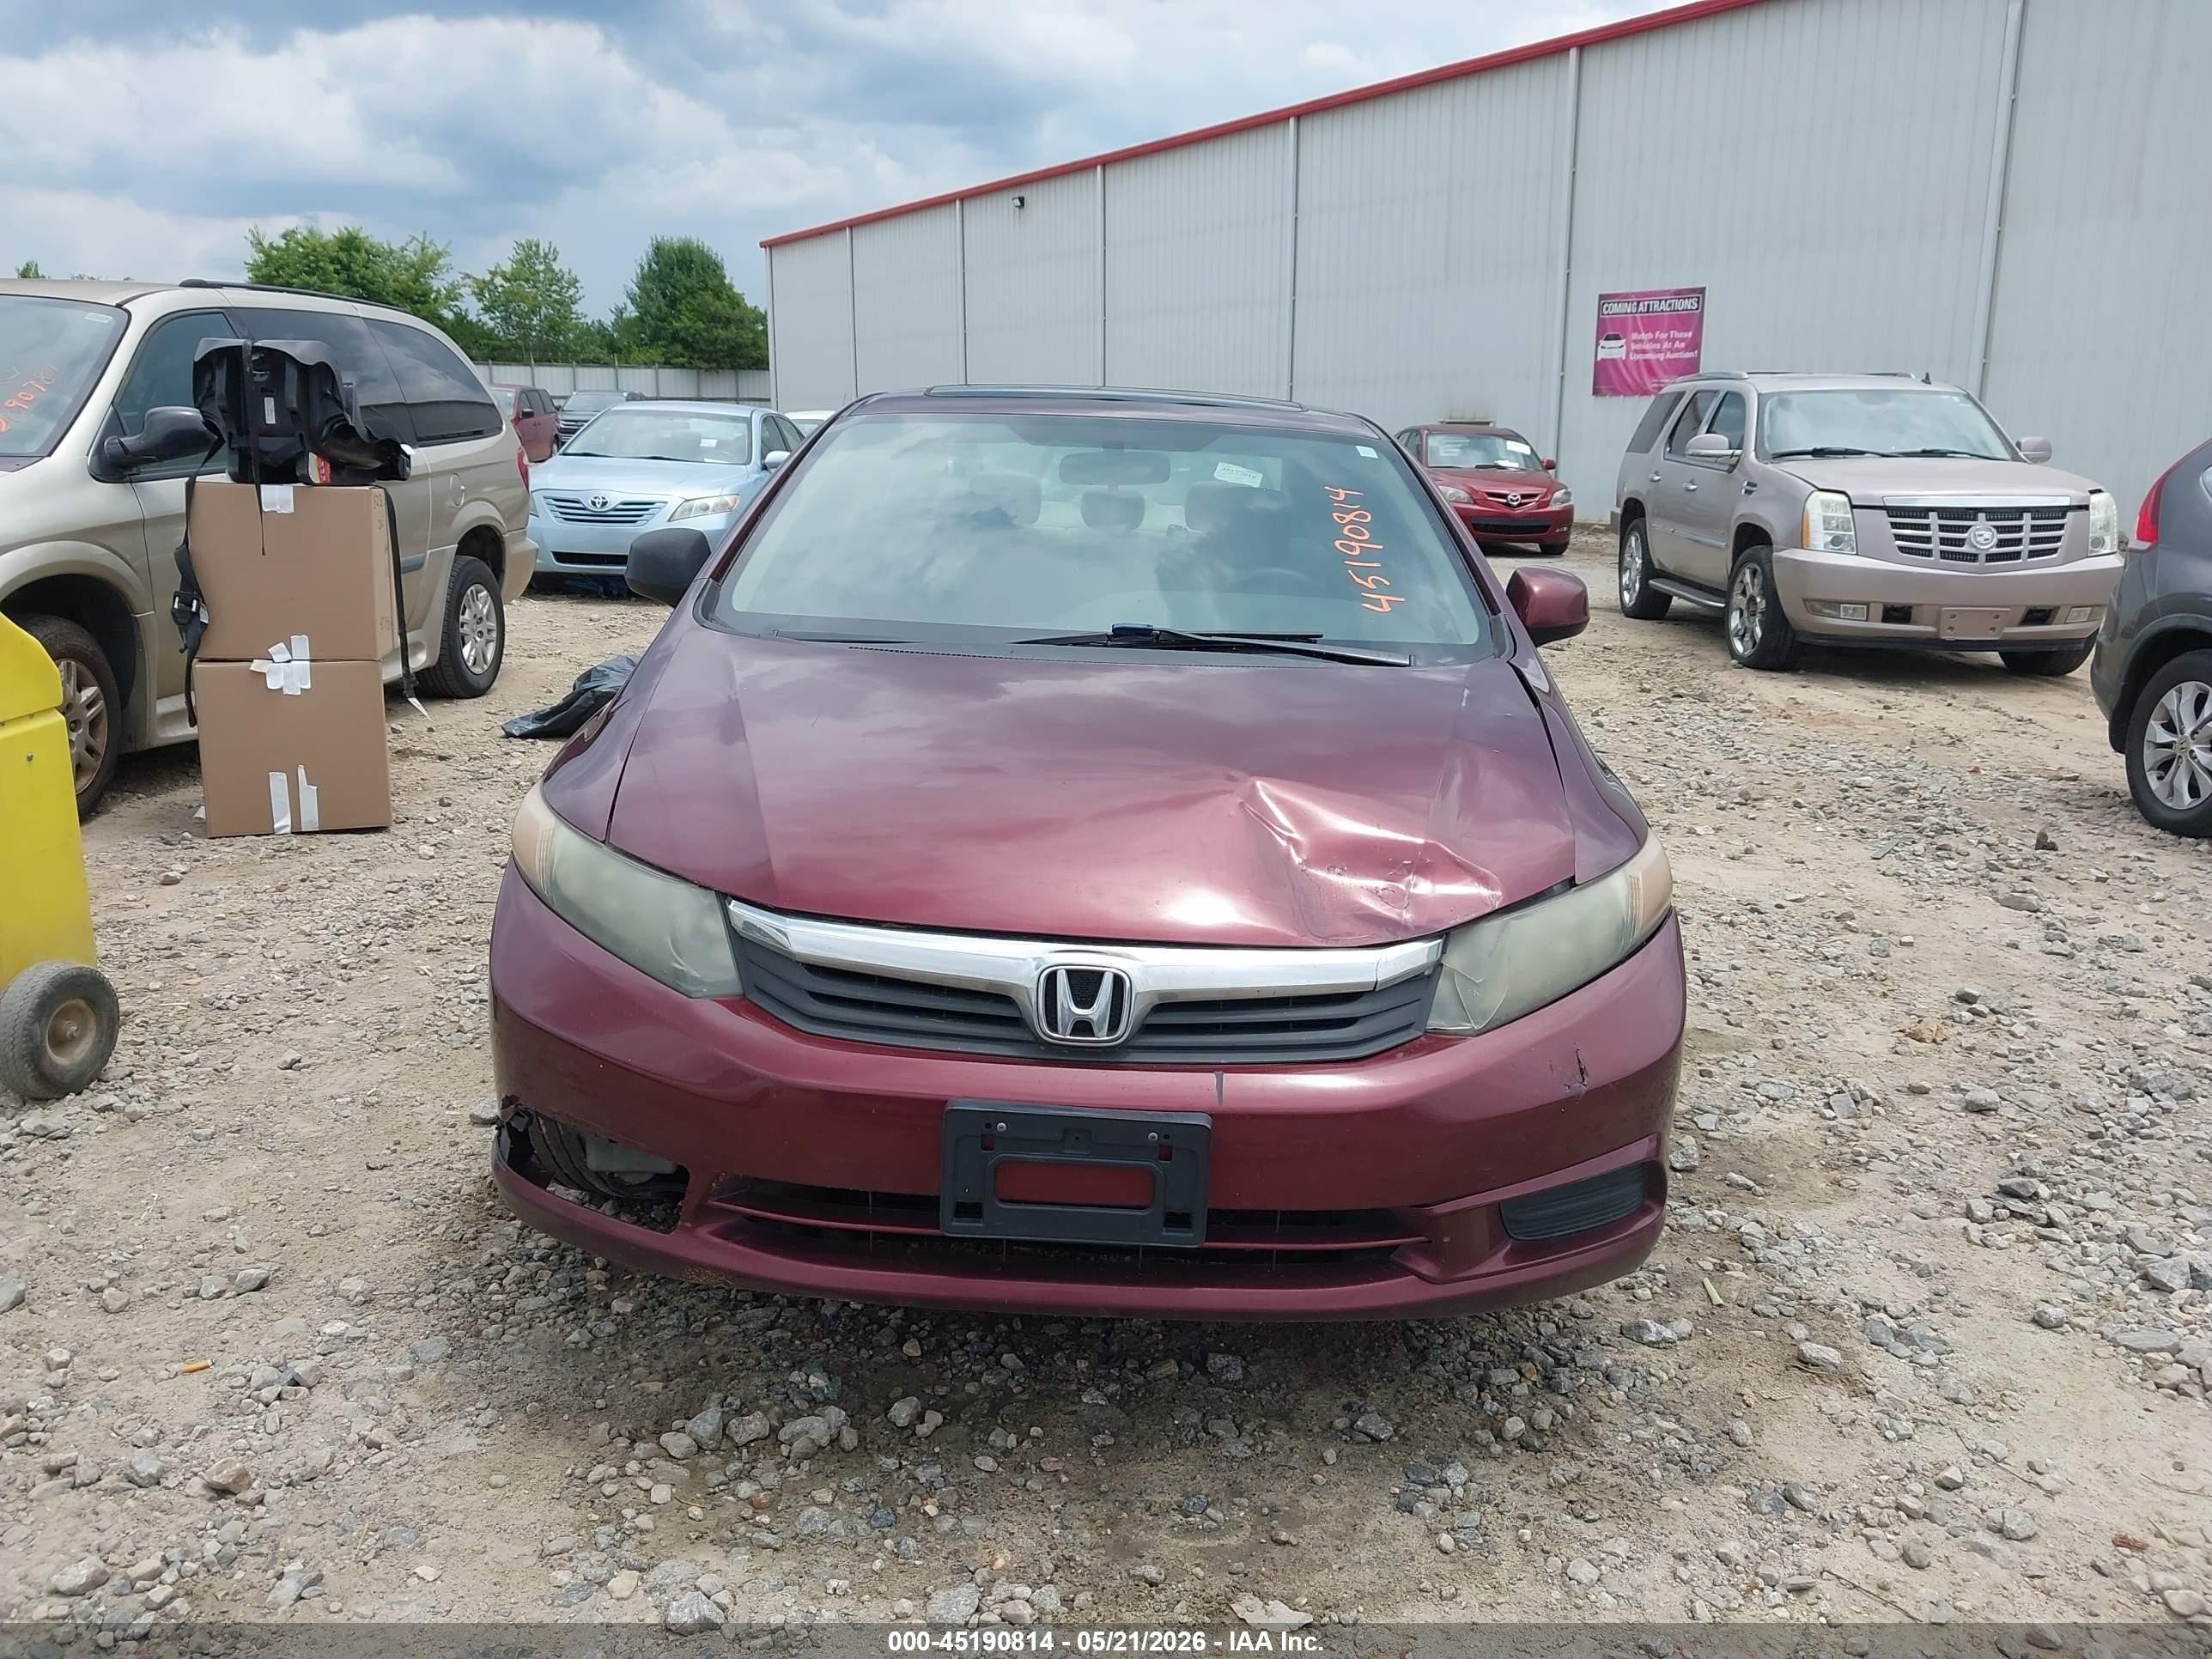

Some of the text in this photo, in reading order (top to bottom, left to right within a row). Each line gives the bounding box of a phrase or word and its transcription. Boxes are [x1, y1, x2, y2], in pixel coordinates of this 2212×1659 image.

[1602, 298, 1698, 314] COMING ATTRACTIONS
[1632, 330, 1693, 340] Watch For These
[1674, 340, 1686, 349] An
[1630, 349, 1698, 361] Upcoming Auction!
[1324, 486, 1406, 612] 45190814
